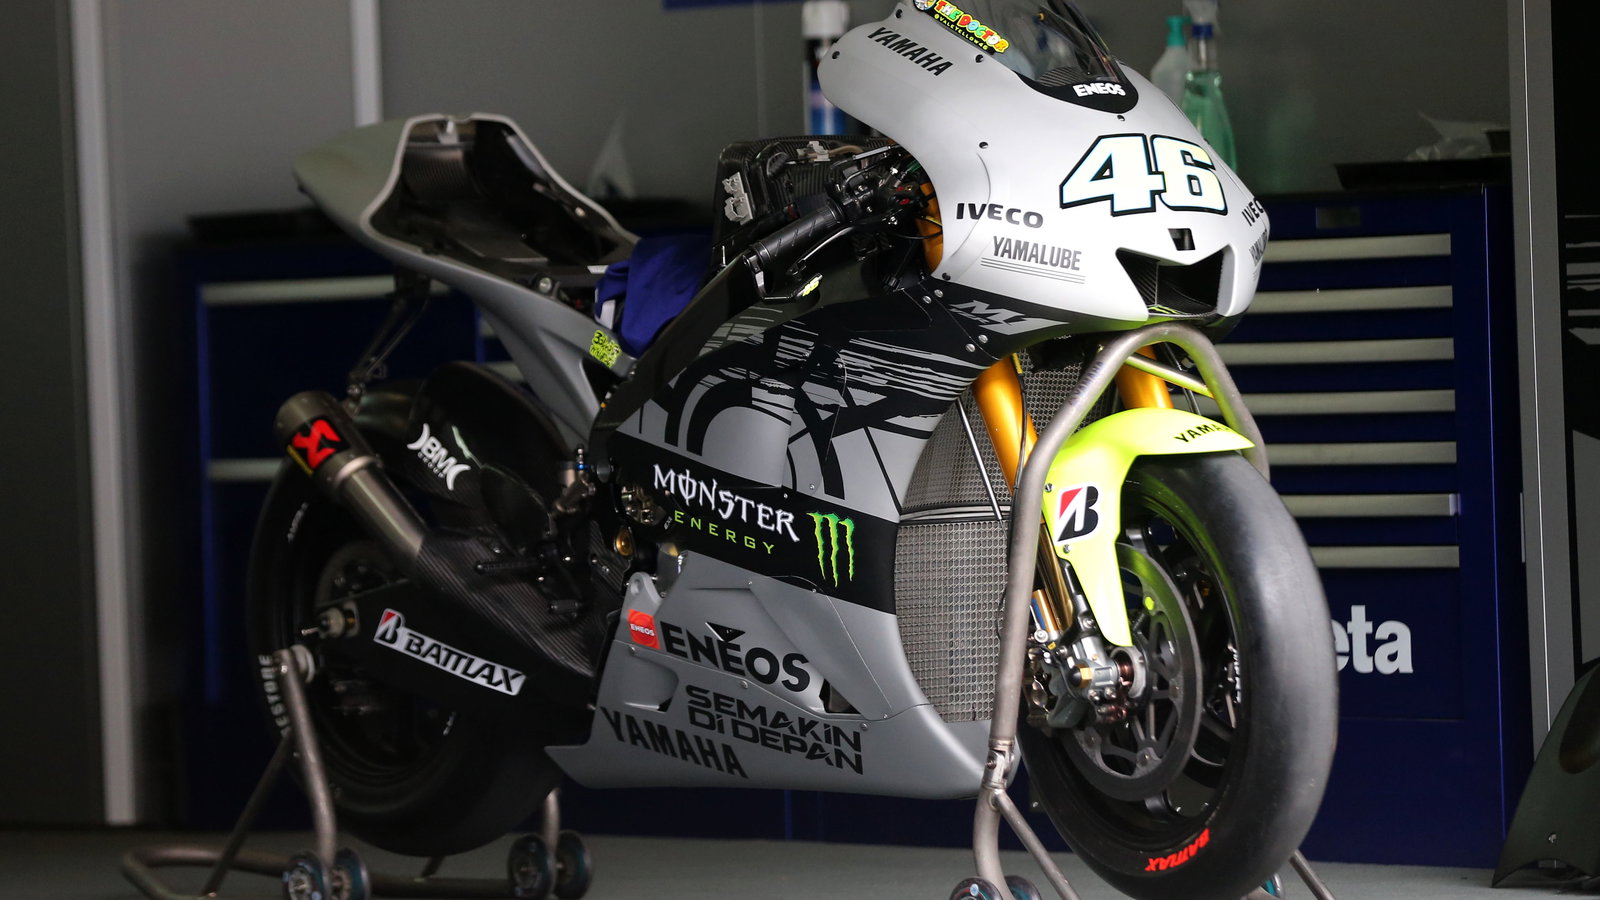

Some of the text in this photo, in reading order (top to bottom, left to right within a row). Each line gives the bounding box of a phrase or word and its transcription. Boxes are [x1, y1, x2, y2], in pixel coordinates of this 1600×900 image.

[934, 0, 1010, 52] THE DOCTOR
[868, 27, 953, 77] YAMAHA
[1073, 82, 1126, 98] ENEOS
[1060, 133, 1228, 217] 46
[956, 202, 1044, 229] IVECO
[1242, 197, 1264, 227] IVEC
[993, 236, 1082, 271] YAMALUBE
[1174, 424, 1229, 443] YAMA
[653, 464, 800, 542] MONSTER
[674, 510, 775, 555] ENERGY
[630, 623, 655, 636] ENEOS
[404, 632, 523, 693] BATTLAX
[659, 621, 811, 692] ENEOS
[600, 706, 750, 778] YAMAHA
[731, 718, 864, 775] DEPAN
